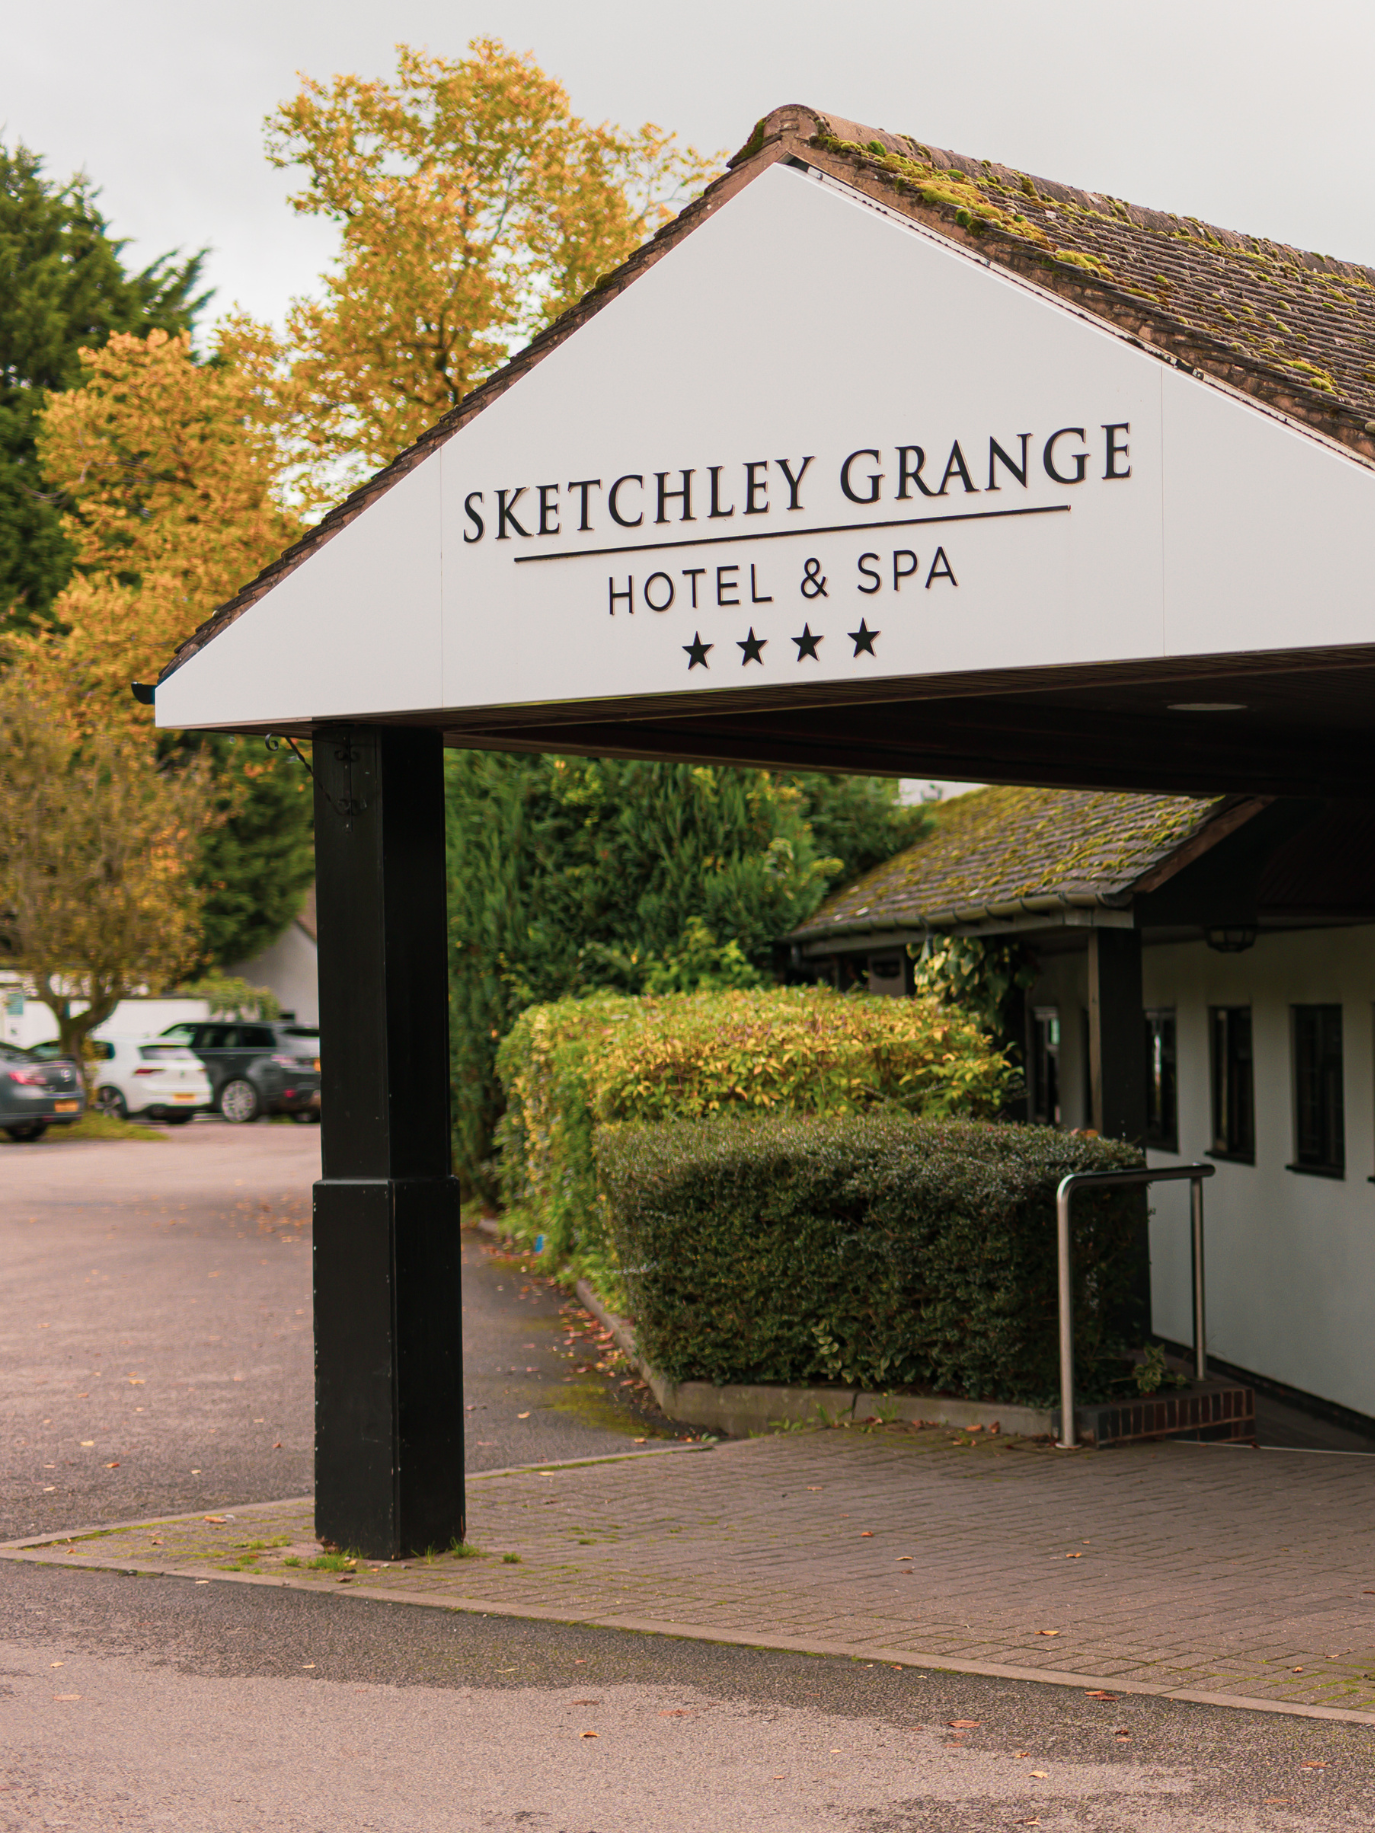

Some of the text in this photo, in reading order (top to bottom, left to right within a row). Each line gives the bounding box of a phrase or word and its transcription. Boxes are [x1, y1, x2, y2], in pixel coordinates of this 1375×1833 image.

[463, 423, 1132, 543] SKETCHLEY GRANGE
[608, 546, 959, 616] HOTEL & SPA
